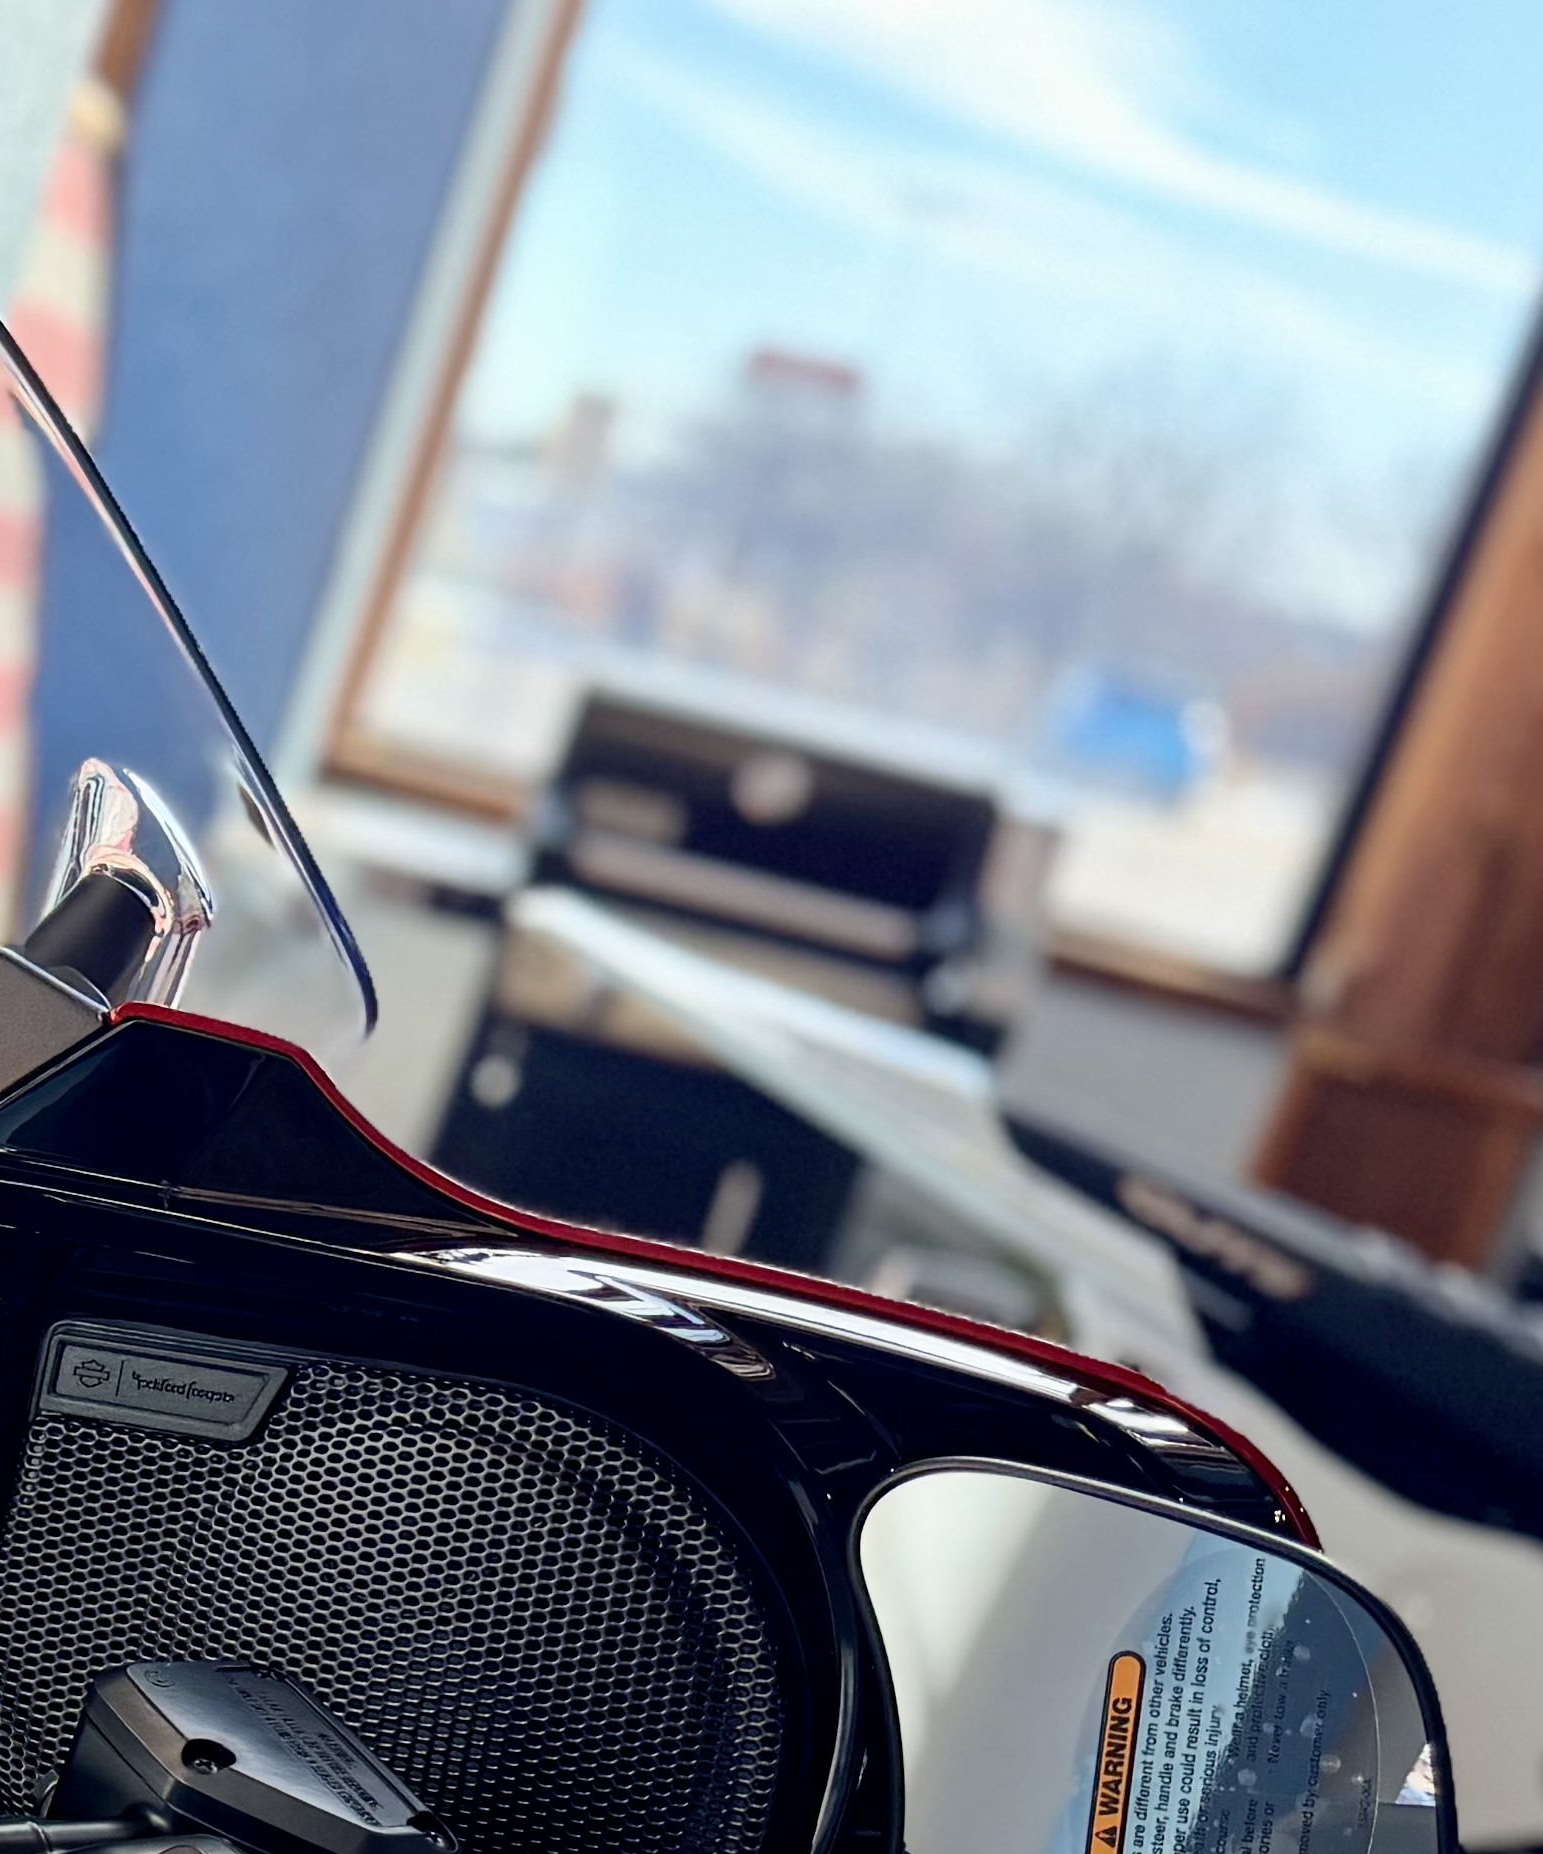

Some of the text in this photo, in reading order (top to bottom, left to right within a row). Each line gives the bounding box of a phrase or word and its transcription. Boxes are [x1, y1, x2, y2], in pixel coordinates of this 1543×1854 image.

[1199, 1577, 1221, 1633] control,
[1154, 1612, 1172, 1674] vehicles.
[1173, 1606, 1195, 1681] differently.
[1197, 1638, 1210, 1652] of
[1192, 1657, 1208, 1686] loss
[1235, 1659, 1253, 1707] helmet,
[1149, 1680, 1163, 1717] other
[1166, 1686, 1183, 1726] brake
[1188, 1690, 1204, 1704] in
[1143, 1723, 1158, 1756] from
[1162, 1732, 1176, 1758] and
[1183, 1709, 1200, 1748] result
[1099, 1696, 1133, 1816] WARNING
[1245, 1736, 1257, 1760] and
[1135, 1761, 1153, 1819] different
[1155, 1763, 1173, 1811] handle
[1178, 1754, 1195, 1793] could
[1198, 1751, 1215, 1806] serious
[1177, 1799, 1189, 1823] use
[1199, 1808, 1208, 1821] or
[1265, 1803, 1274, 1815] or
[1304, 1790, 1318, 1807] by
[1133, 1825, 1144, 1846] are
[1151, 1816, 1167, 1854] steer,
[1243, 1799, 1258, 1842] before
